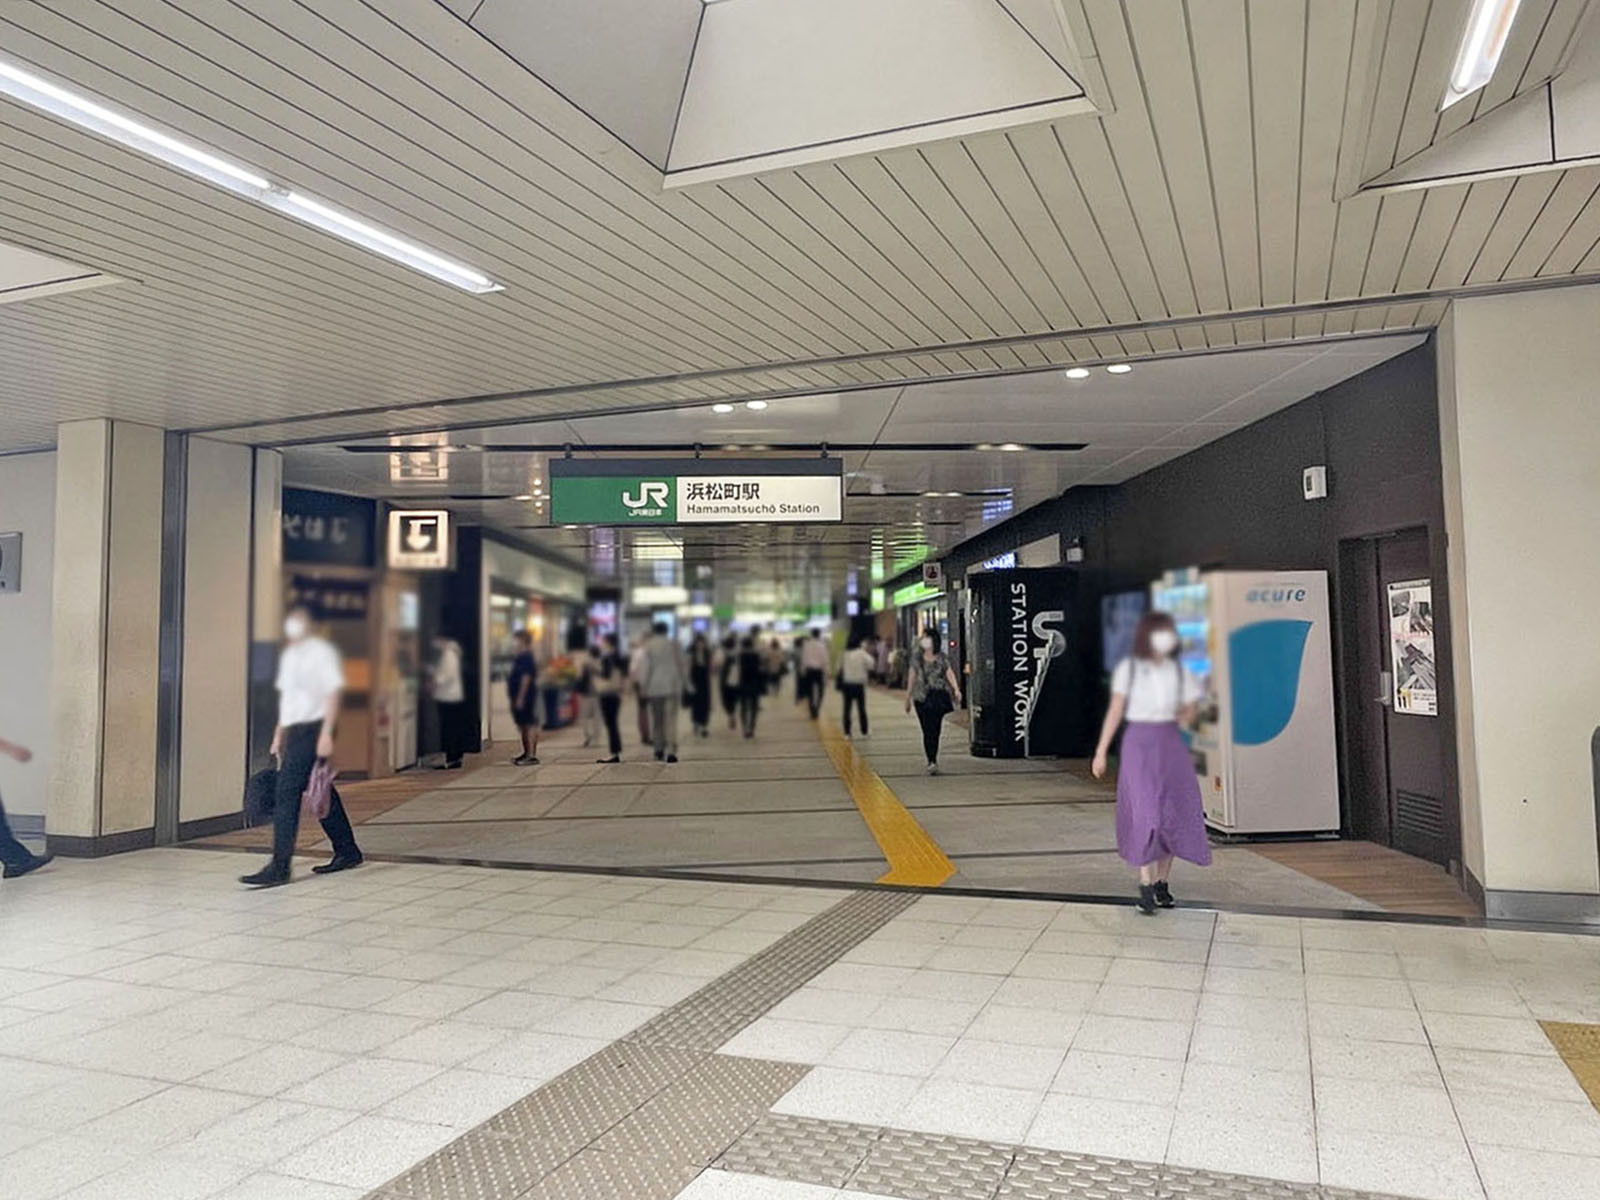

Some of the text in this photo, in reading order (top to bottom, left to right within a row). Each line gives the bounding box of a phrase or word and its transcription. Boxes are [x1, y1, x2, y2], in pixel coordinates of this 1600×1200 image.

[622, 482, 669, 508] JR
[686, 482, 760, 501] 浜松町駅
[779, 502, 820, 513] Station
[1245, 588, 1306, 602] acure
[1010, 582, 1030, 742] STATION WORK
